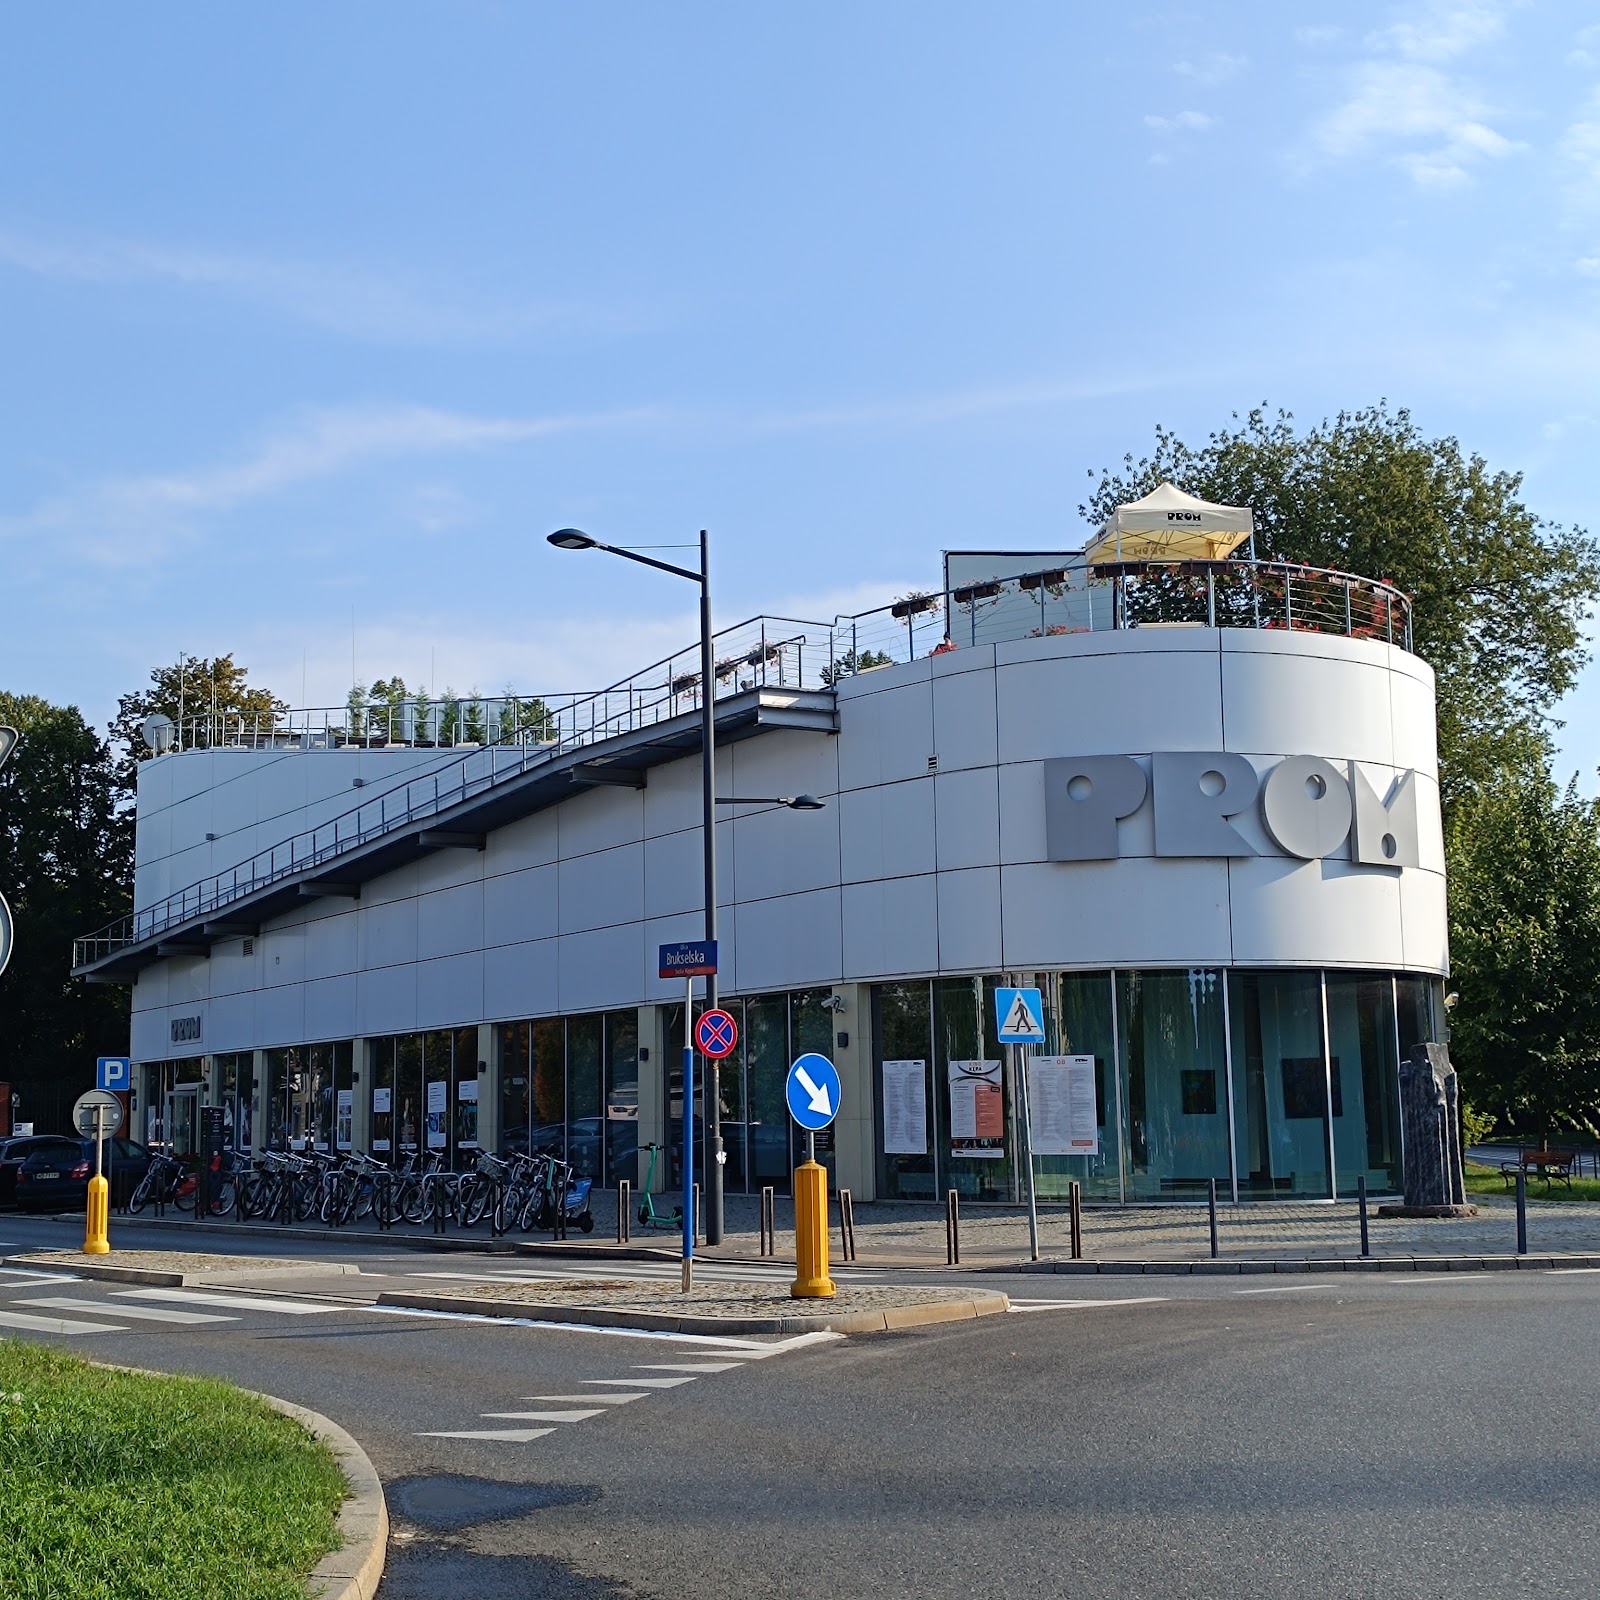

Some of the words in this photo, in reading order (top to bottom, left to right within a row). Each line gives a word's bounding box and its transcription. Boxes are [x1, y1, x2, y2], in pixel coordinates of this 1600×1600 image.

[1167, 512, 1201, 521] PROM
[1044, 751, 1419, 868] PROM
[666, 950, 705, 966] Brukselska
[171, 1015, 201, 1041] PROM
[104, 1060, 124, 1087] P
